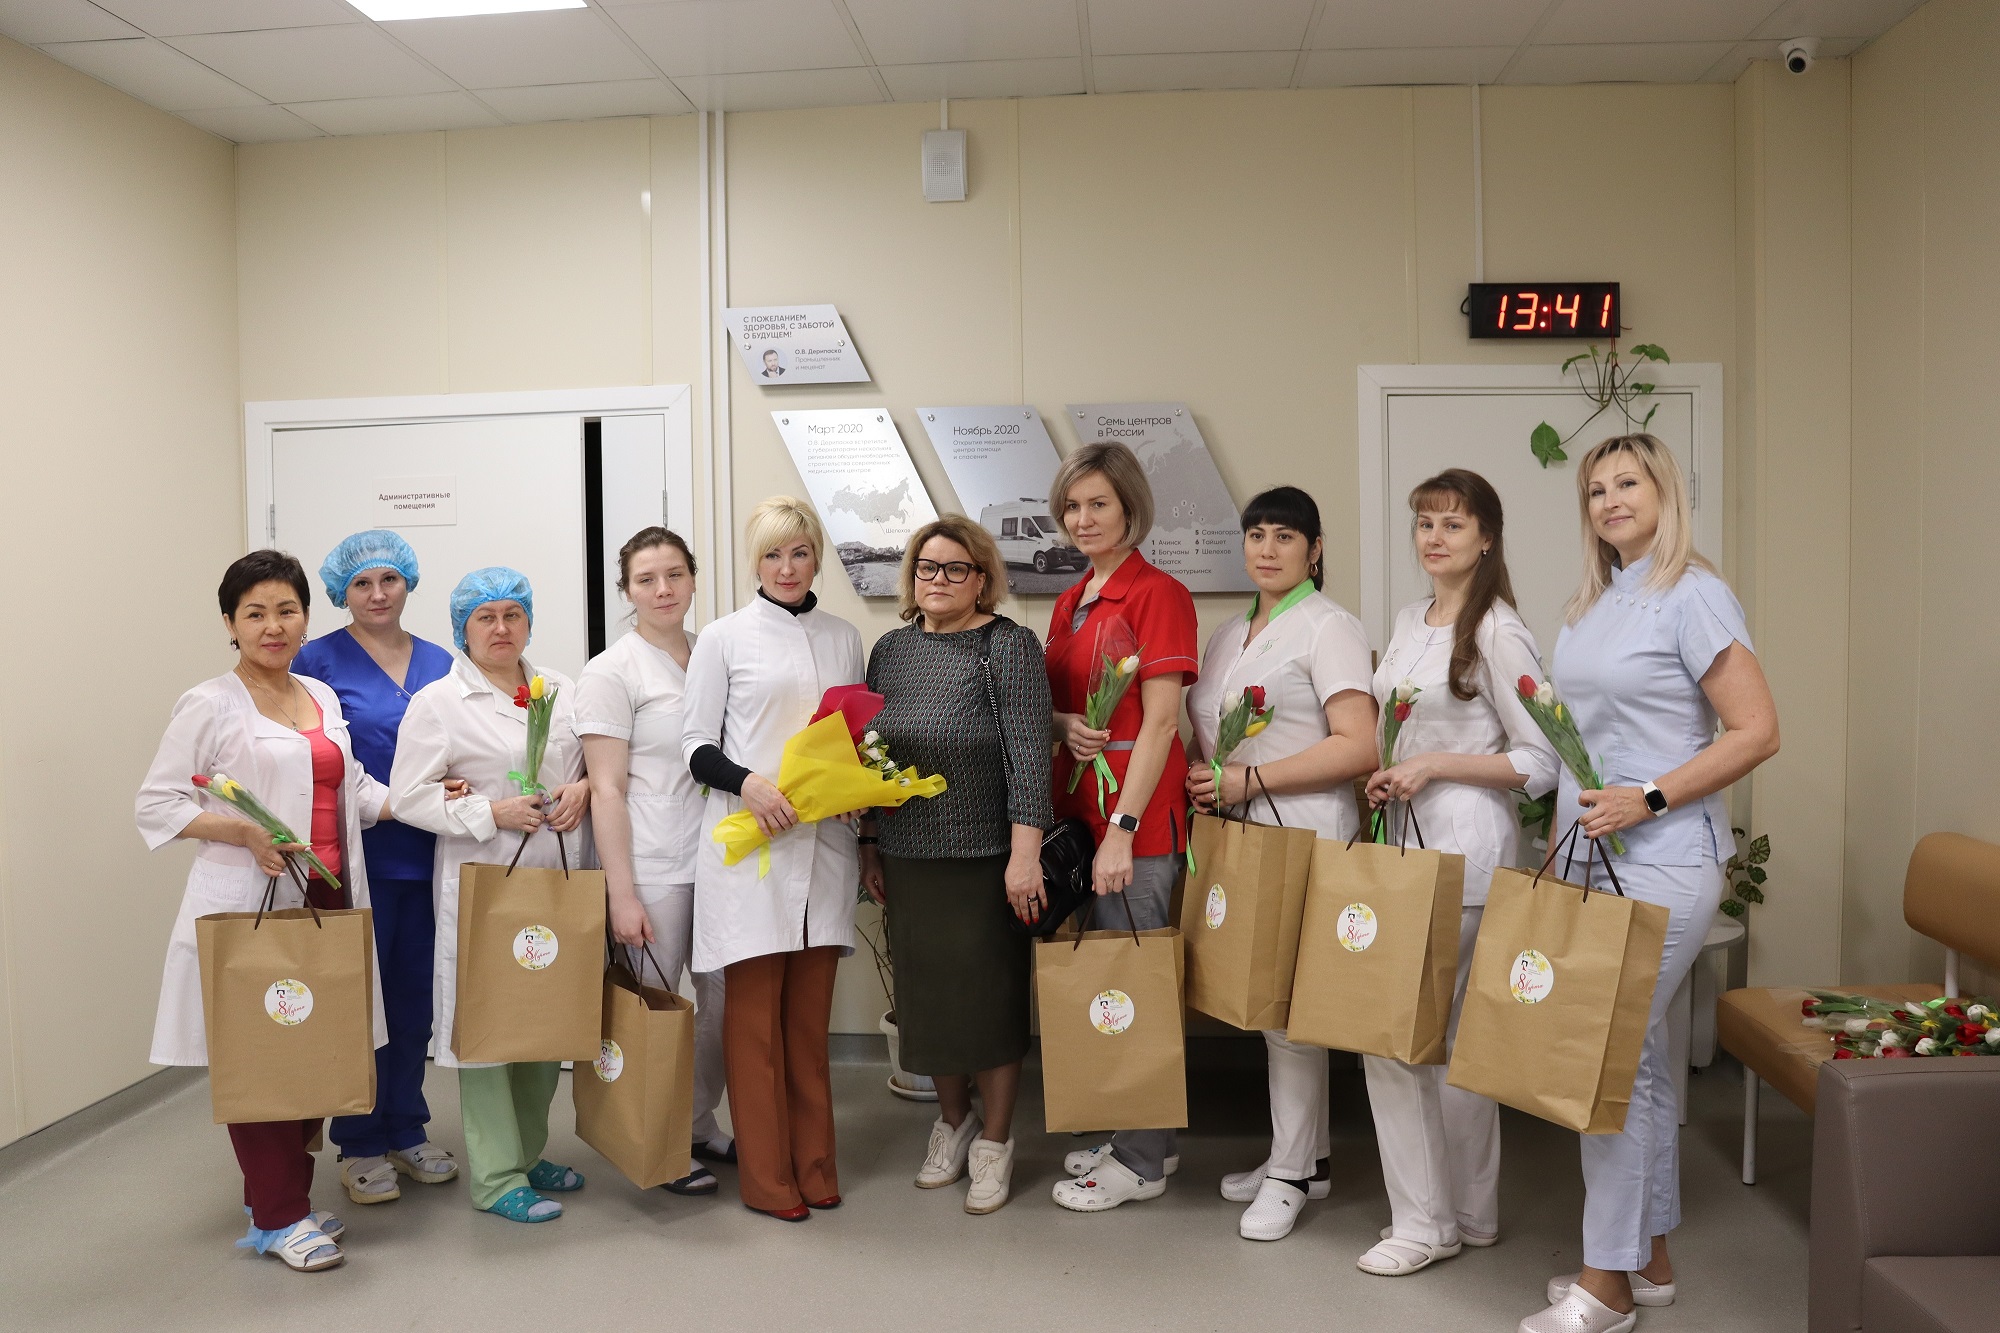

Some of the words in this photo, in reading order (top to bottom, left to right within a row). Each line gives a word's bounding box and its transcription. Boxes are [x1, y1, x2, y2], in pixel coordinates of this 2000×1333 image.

[1498, 292, 1611, 330] 13:41
[750, 314, 806, 323] ПОЖЕЛАНИЕМ
[743, 323, 788, 332] ЗДОРОВЬЯ,
[798, 320, 834, 330] ЗАБОТОЙ
[752, 332, 792, 340] БУДУЩЕМ!
[1097, 416, 1125, 426] Семь
[1127, 416, 1172, 427] центров
[808, 425, 835, 436] Март
[838, 424, 864, 434] 2020
[953, 426, 992, 437] Ноябрь
[994, 424, 1020, 435] 2020
[1106, 428, 1145, 437] России
[378, 492, 451, 501] Административные
[1347, 925, 1354, 940] 8
[526, 946, 533, 960] 8
[1518, 973, 1526, 990] 8
[279, 1001, 286, 1015] 8
[1103, 1011, 1110, 1025] 8
